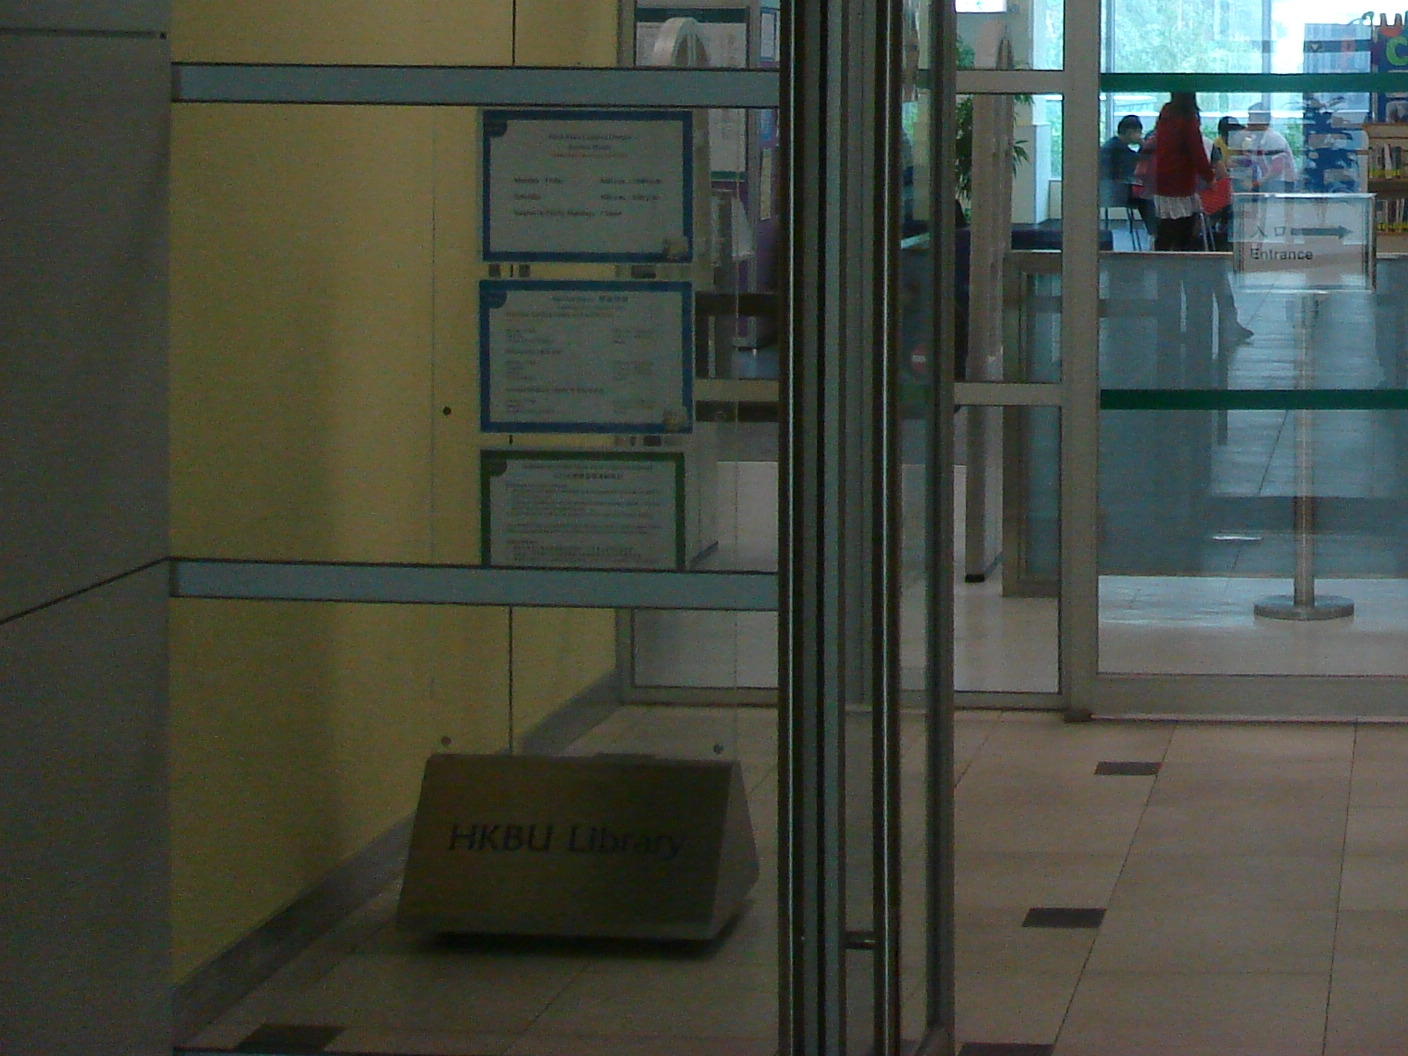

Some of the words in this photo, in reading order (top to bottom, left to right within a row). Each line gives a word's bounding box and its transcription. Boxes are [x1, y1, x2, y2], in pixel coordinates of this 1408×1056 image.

[1250, 248, 1314, 261] Entrance
[448, 823, 554, 852] HKBU
[568, 826, 685, 861] Library
